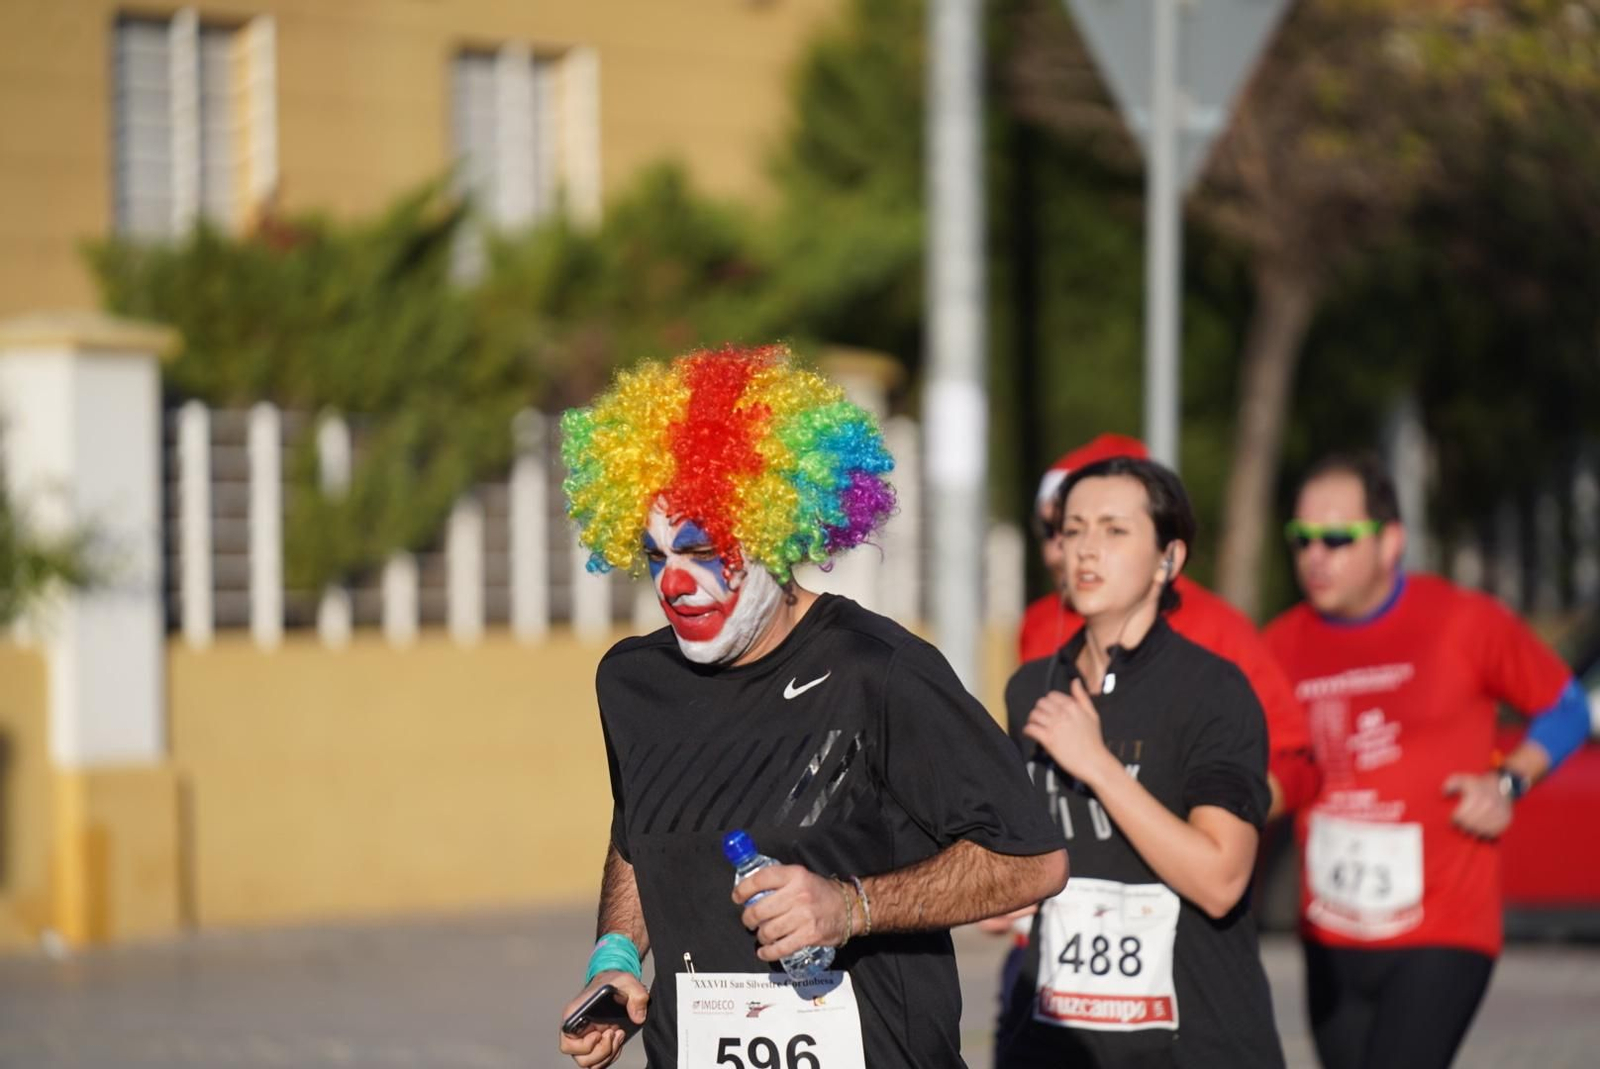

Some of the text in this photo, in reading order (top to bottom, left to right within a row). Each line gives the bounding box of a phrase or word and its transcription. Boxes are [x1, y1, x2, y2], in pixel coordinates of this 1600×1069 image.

[1058, 932, 1142, 977] 488
[694, 976, 835, 990] XXXVII San Silvestre Cordobesa
[701, 1000, 735, 1011] IMDECO
[716, 1034, 820, 1069] 596
